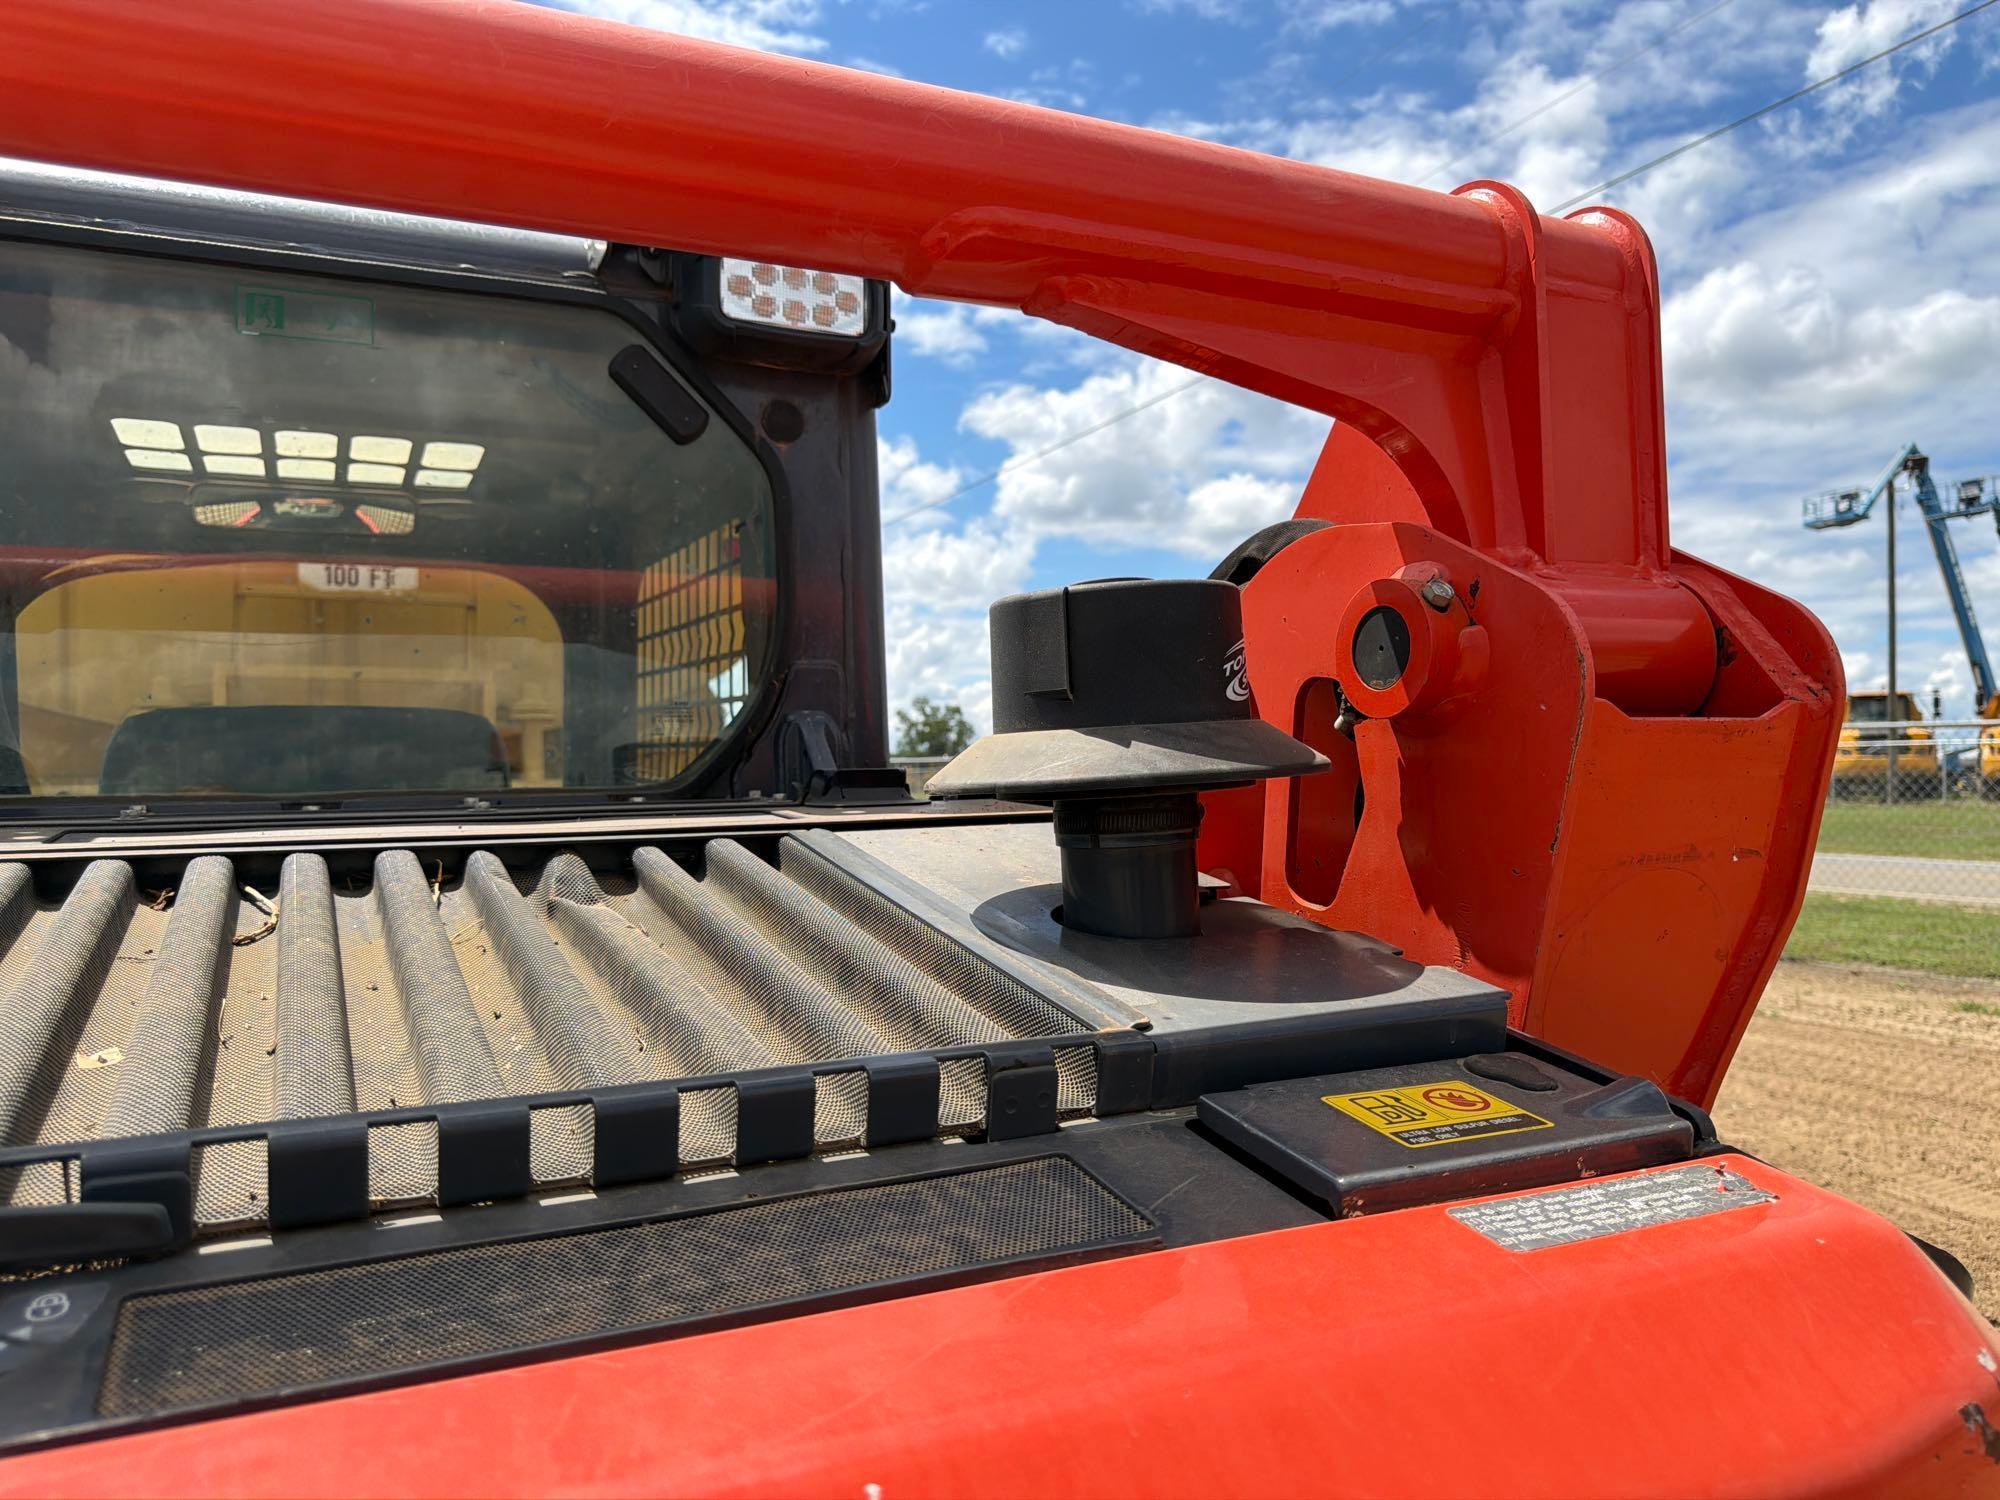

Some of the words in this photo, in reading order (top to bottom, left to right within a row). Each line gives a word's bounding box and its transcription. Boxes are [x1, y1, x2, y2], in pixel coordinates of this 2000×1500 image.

[324, 566, 360, 586] 100
[1399, 1129, 1431, 1138] ULTRA
[1431, 1125, 1453, 1134] LOW
[1453, 1120, 1490, 1130] SULFUR
[1491, 1116, 1523, 1125] DIESEL
[1409, 1136, 1434, 1144] FUEL
[1436, 1131, 1461, 1140] ONLY
[1481, 1212, 1517, 1222] Power
[1518, 1206, 1542, 1216] OFF
[1492, 1219, 1528, 1229] Press
